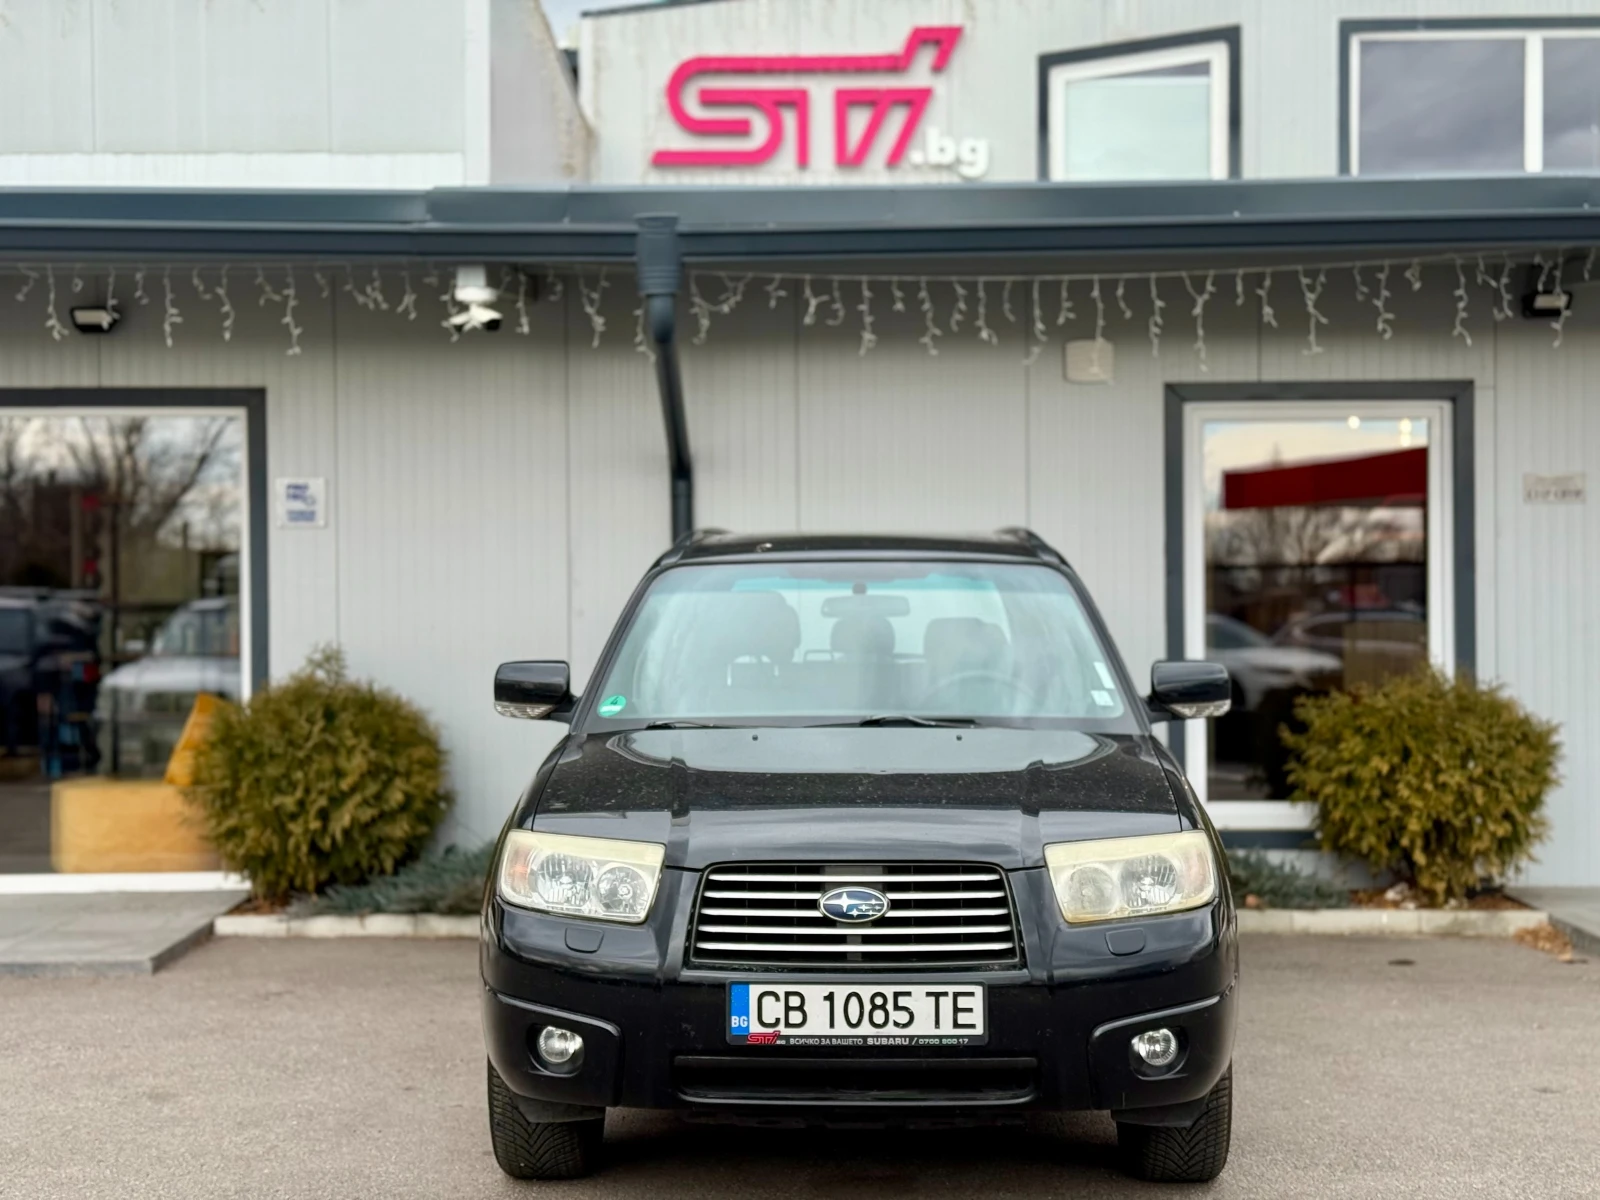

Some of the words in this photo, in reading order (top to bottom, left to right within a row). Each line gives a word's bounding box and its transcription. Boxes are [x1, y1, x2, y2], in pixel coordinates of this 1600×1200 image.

[757, 990, 808, 1029] CB
[823, 991, 915, 1029] 1085
[925, 991, 976, 1029] TE
[731, 1016, 748, 1028] BG
[867, 1037, 909, 1045] SUBARU
